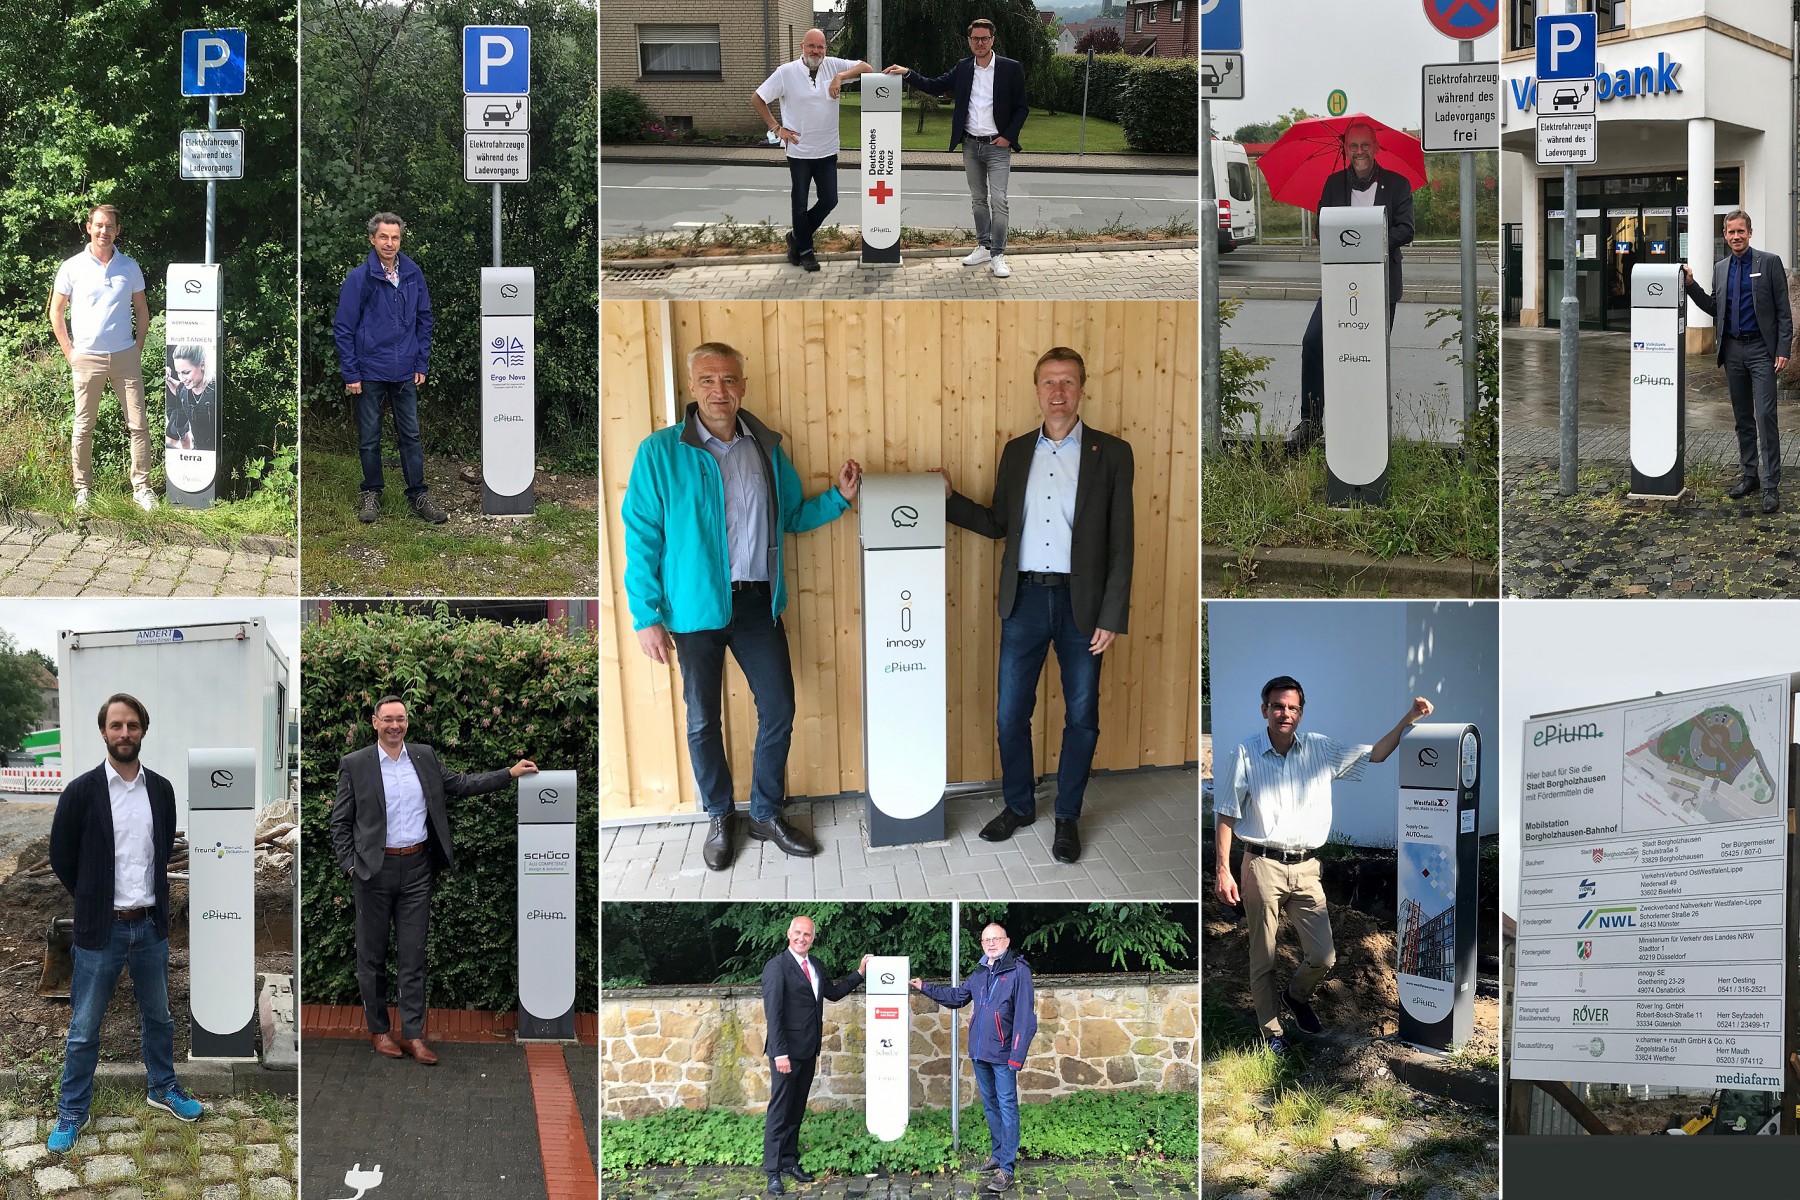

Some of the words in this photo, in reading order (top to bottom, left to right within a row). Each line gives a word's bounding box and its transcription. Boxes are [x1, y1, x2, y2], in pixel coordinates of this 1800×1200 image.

[1551, 23, 1582, 71] P
[197, 38, 230, 86] P
[480, 36, 514, 85] P
[1429, 73, 1499, 84] Elektrofahrzeug
[1511, 52, 1681, 111] Vbank
[1332, 94, 1341, 111] H
[1437, 92, 1474, 103] während
[1479, 91, 1494, 101] des
[1435, 112, 1495, 123] Ladevorgangs
[1541, 123, 1592, 131] Elektrofahrzeuge
[1454, 129, 1477, 141] frei
[186, 138, 238, 147] Elektrofahrzeuge
[470, 140, 524, 150] Elektrofahrzeuge
[1545, 149, 1586, 158] Ladevorgangs
[190, 164, 233, 173] Ladevorgangs
[475, 166, 519, 176] Ladevorgangs
[1338, 320, 1369, 330] innogy
[137, 630, 173, 638] ANDERT
[886, 638, 926, 648] innogy
[1534, 723, 1604, 747] ePium
[1527, 772, 1540, 780] Hier
[1542, 769, 1556, 777] baut
[1558, 768, 1567, 776] für
[1569, 766, 1580, 774] Sie
[1582, 764, 1592, 772] die
[1527, 781, 1545, 790] Stadt
[1547, 774, 1606, 788] Borgholzhausen
[1526, 793, 1536, 801] mit
[1538, 788, 1581, 800] Fördermitteln
[1526, 819, 1569, 830] Mobilstation
[1526, 824, 1618, 841] Borgholzhausen-Bahnhof
[1657, 837, 1701, 846] Borgholzhausen
[1733, 838, 1775, 848] Bürgermeister
[524, 851, 569, 859] SCHÜCO
[1660, 853, 1703, 862] Borgholzhausen
[1641, 871, 1688, 880] VerkehrsVerbund
[1640, 903, 1679, 911] Zweckverband
[1714, 899, 1761, 907] Westfalen-Lippe
[1600, 915, 1636, 928] NWL
[1573, 1005, 1609, 1022] RÖVER
[1518, 1042, 1554, 1050] Bauausführung
[1716, 1072, 1780, 1086] mediafarm
